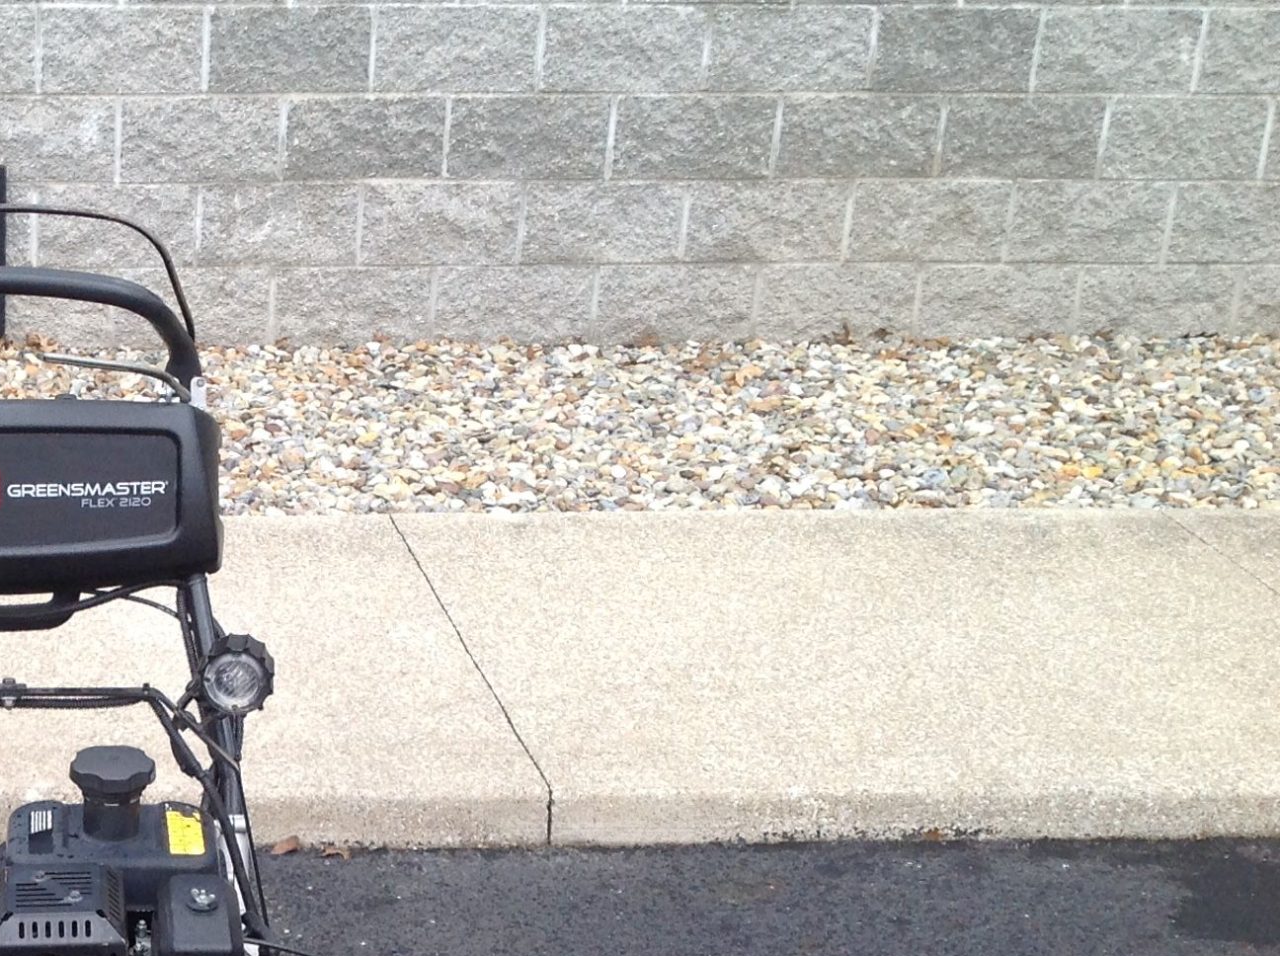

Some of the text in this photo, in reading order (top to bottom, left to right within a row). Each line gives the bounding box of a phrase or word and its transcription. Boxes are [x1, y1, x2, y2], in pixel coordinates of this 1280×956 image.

[6, 480, 168, 498] GREENSMASTER
[80, 496, 152, 509] FLEX 2120
